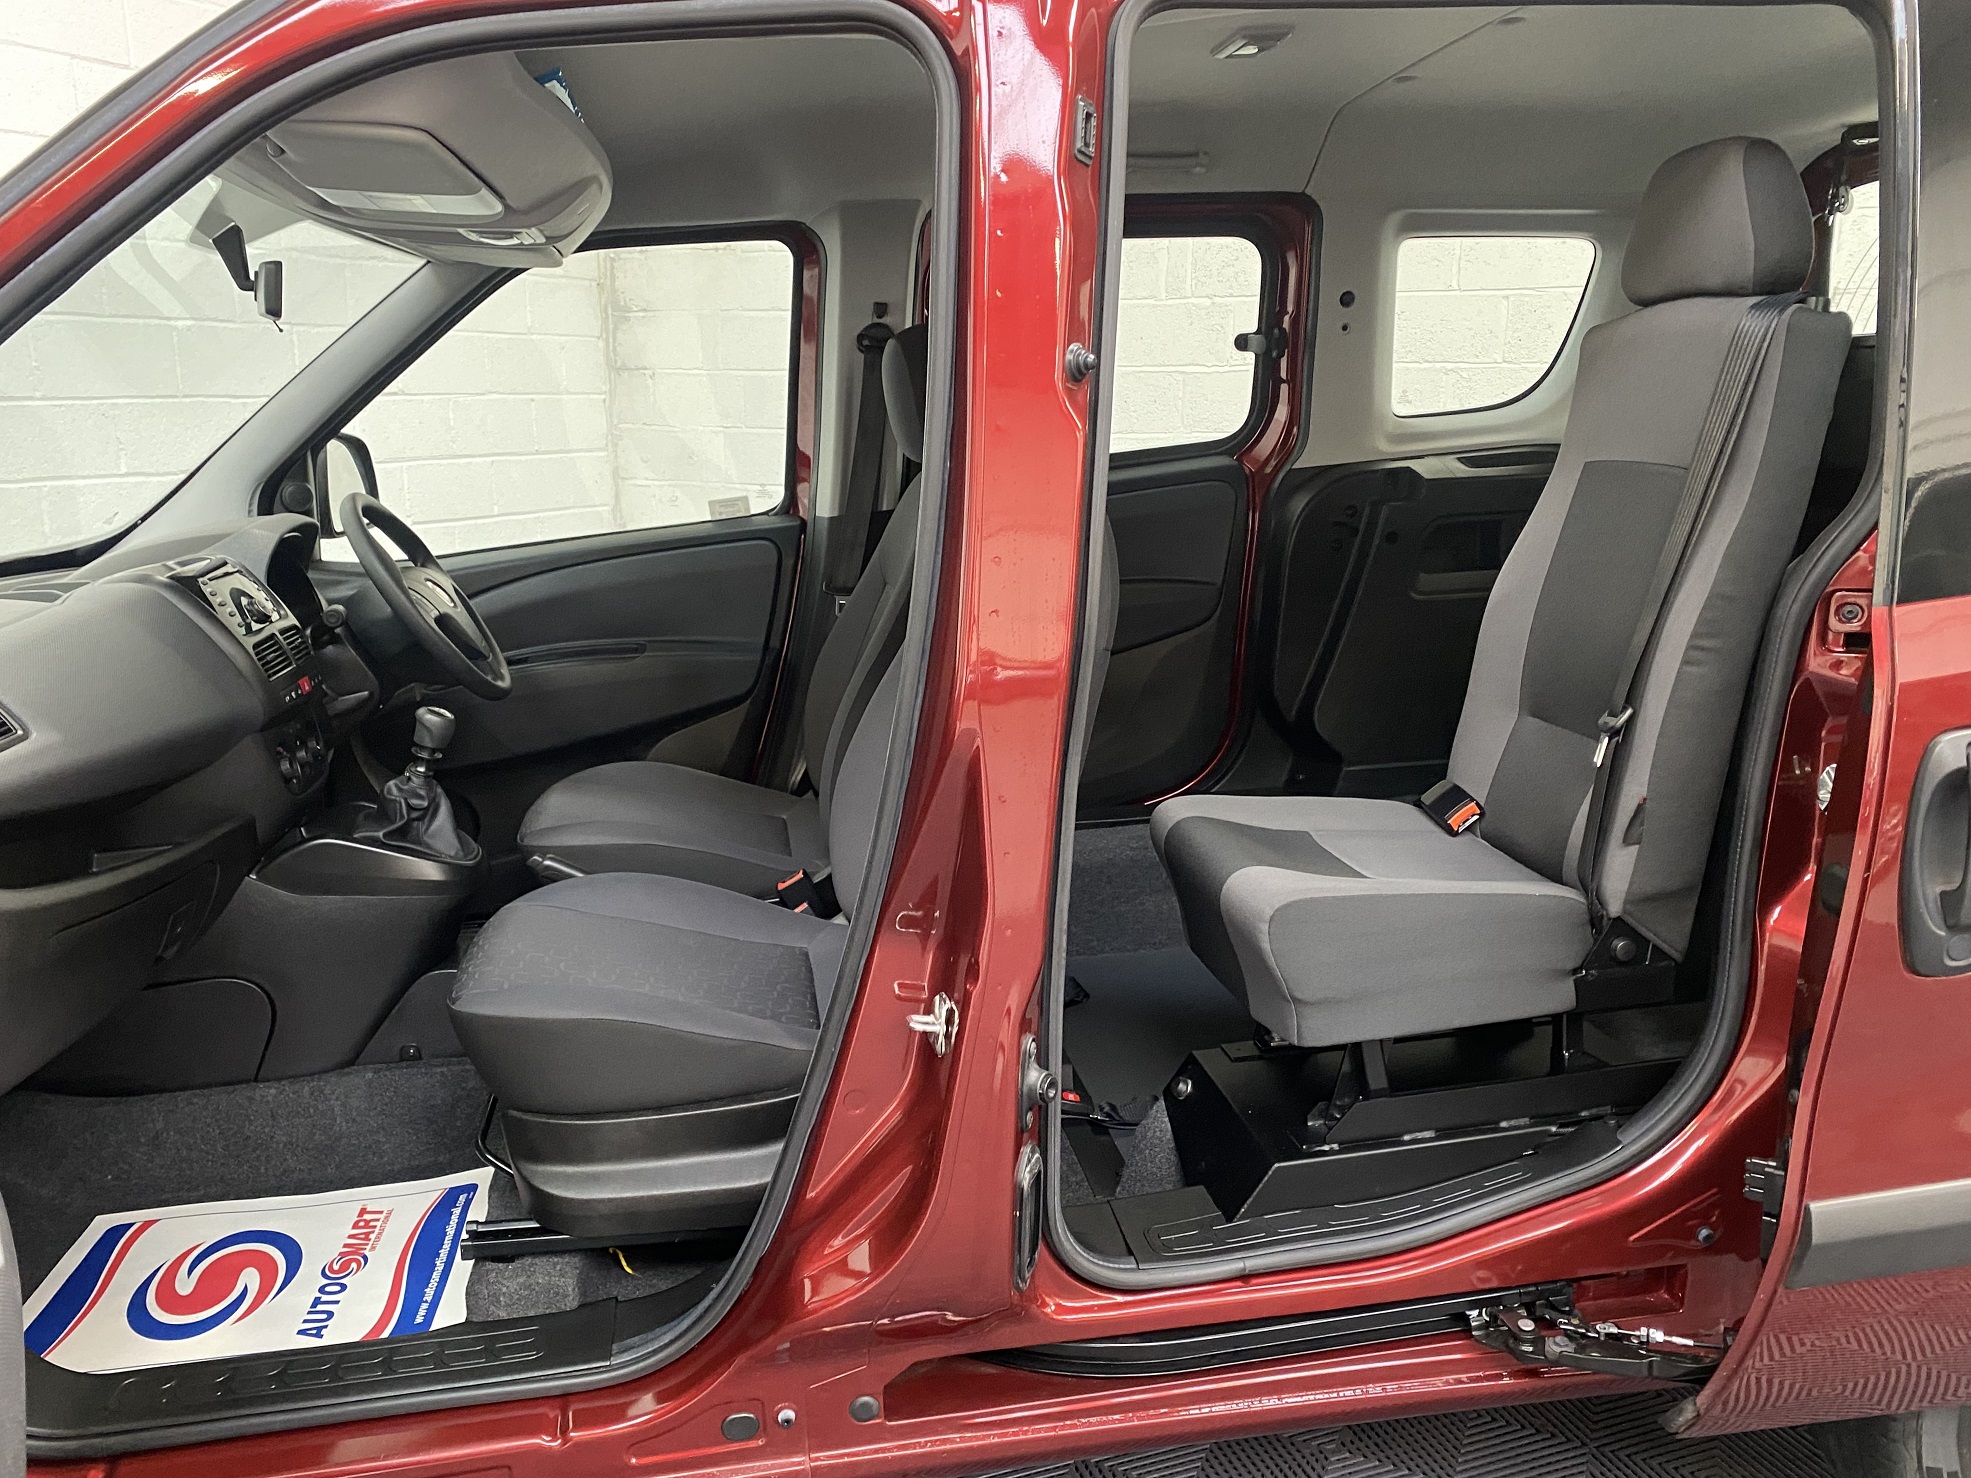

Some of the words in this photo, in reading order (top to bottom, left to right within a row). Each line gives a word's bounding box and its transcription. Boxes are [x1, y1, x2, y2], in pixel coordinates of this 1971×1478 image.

[296, 1207, 384, 1339] AUTOSMART
[369, 1208, 394, 1252] INTERNATIONAL
[414, 1193, 468, 1325] www.autosmartinternational.com
